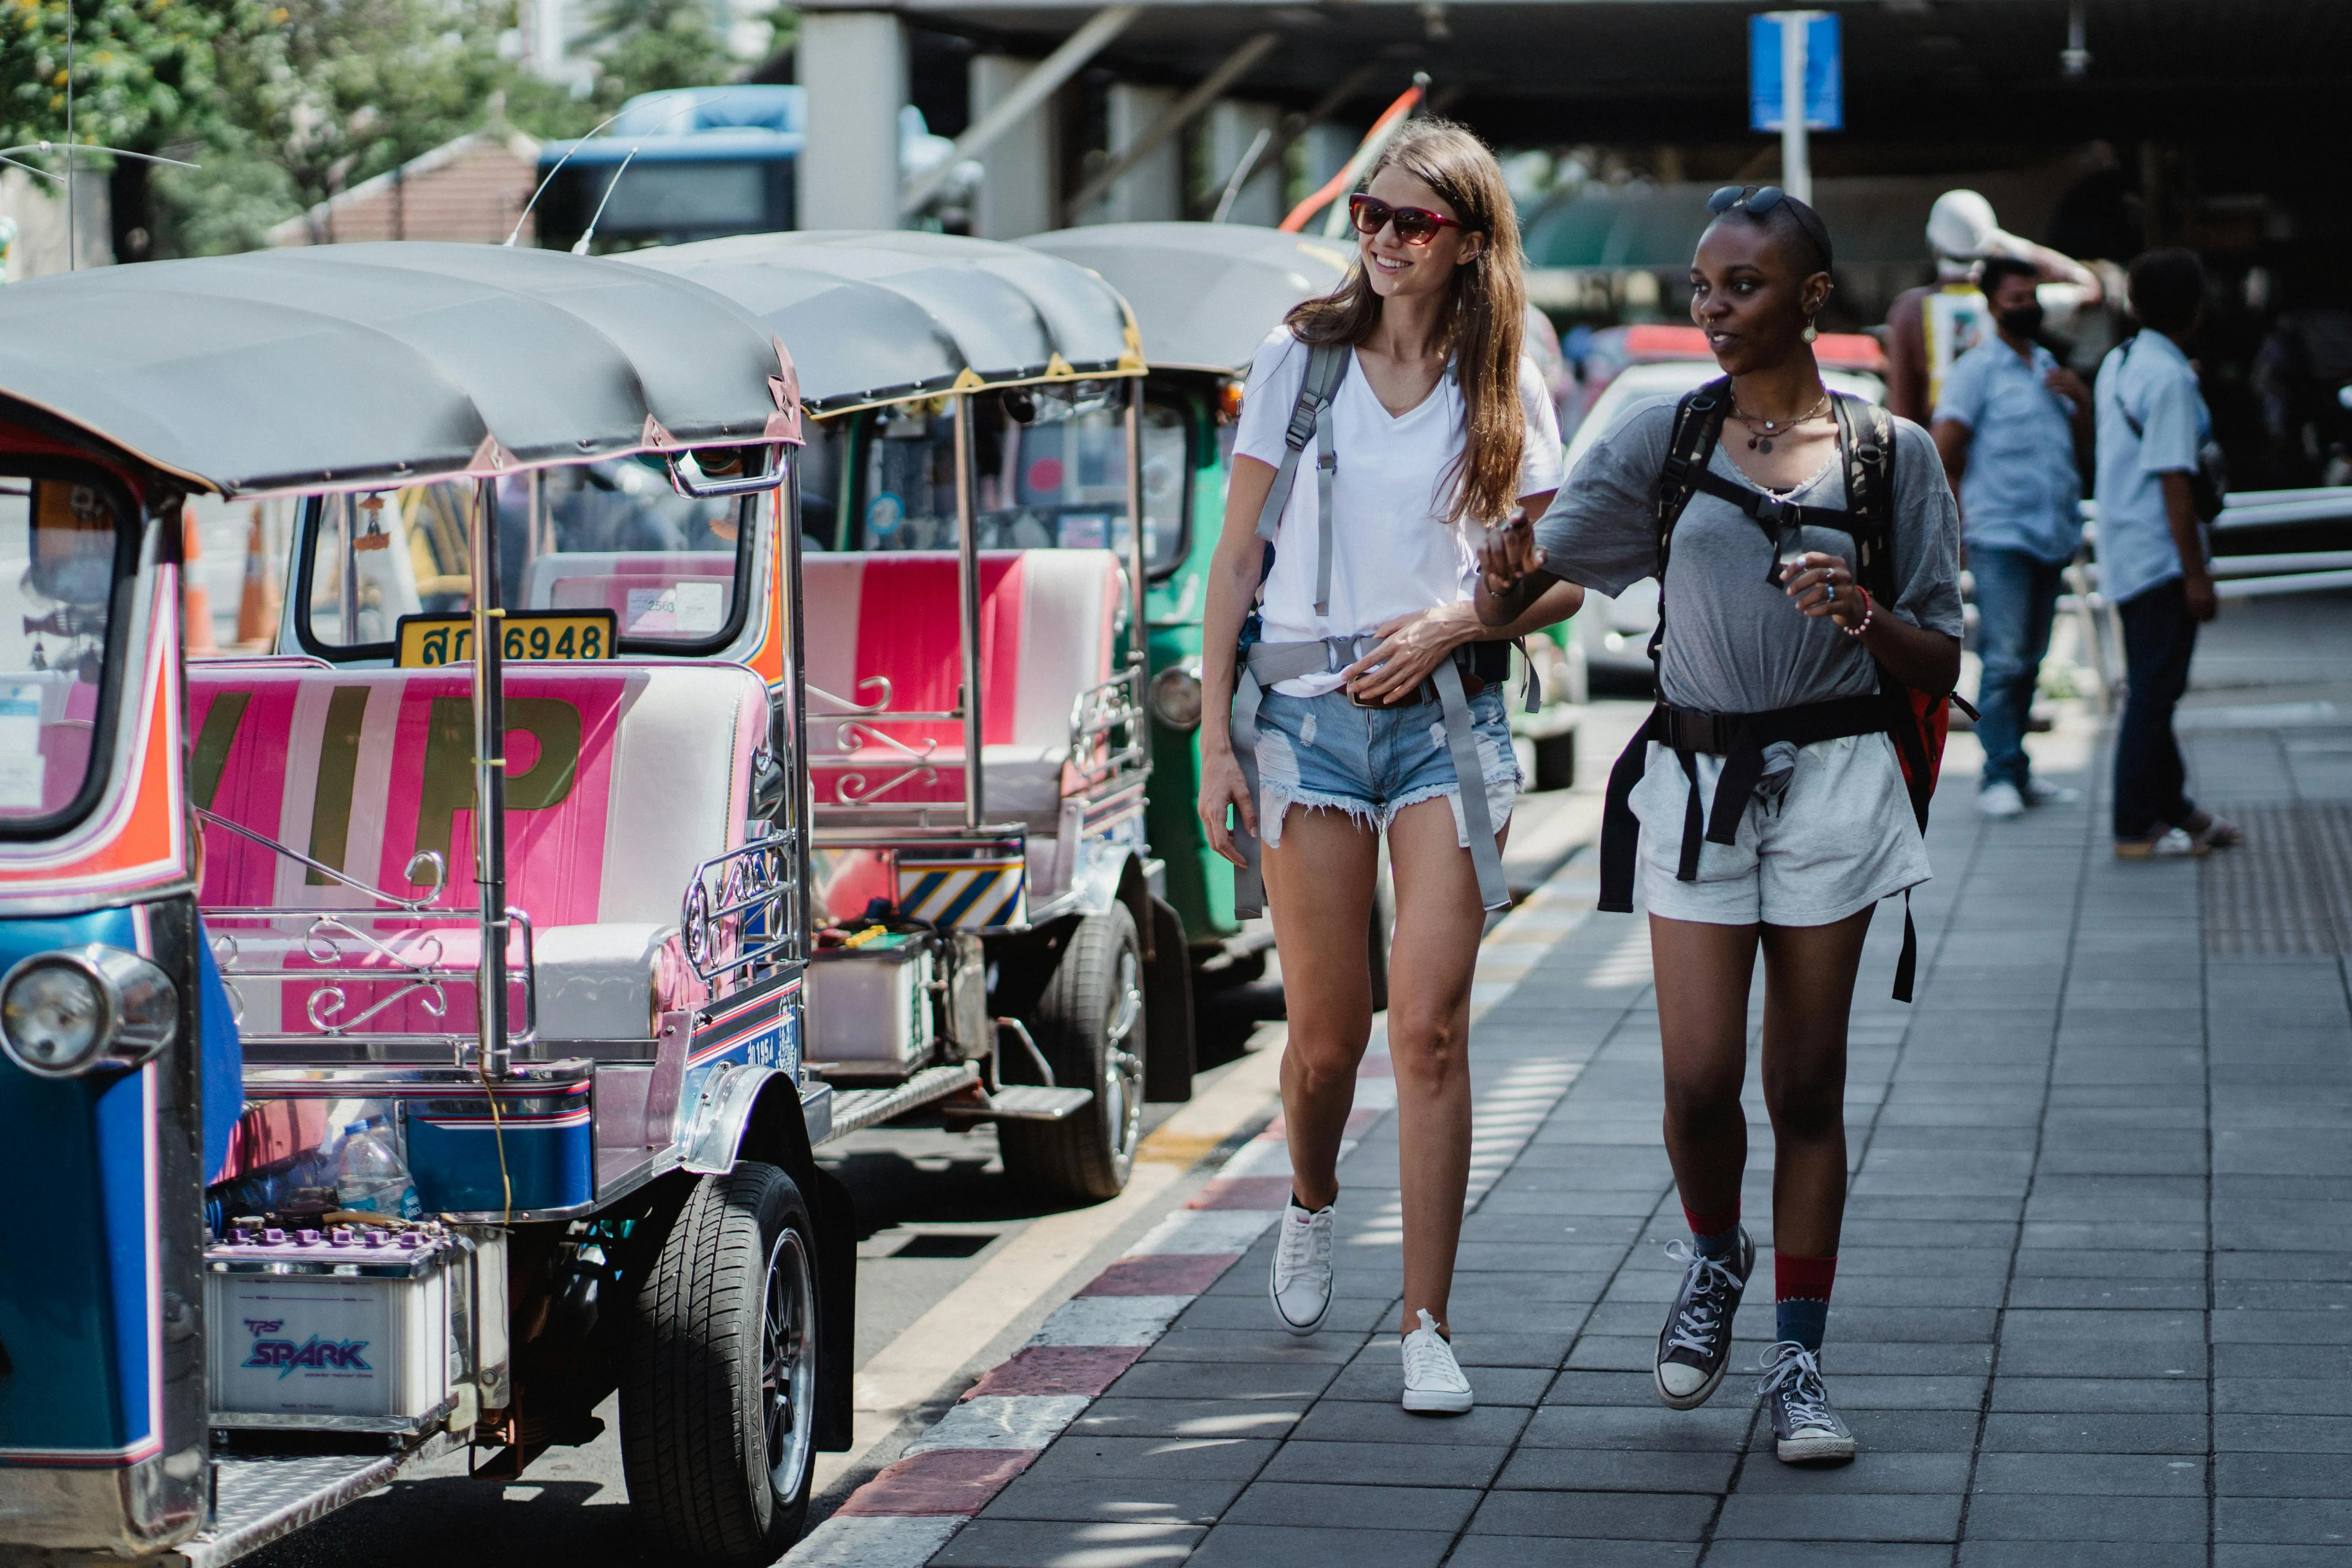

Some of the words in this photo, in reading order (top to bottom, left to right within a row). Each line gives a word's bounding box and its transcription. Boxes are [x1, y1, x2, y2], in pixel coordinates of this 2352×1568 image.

[648, 600, 675, 613] 2563
[504, 626, 601, 659] 6948
[244, 1318, 284, 1337] TPS
[241, 1334, 372, 1373] SPARK
